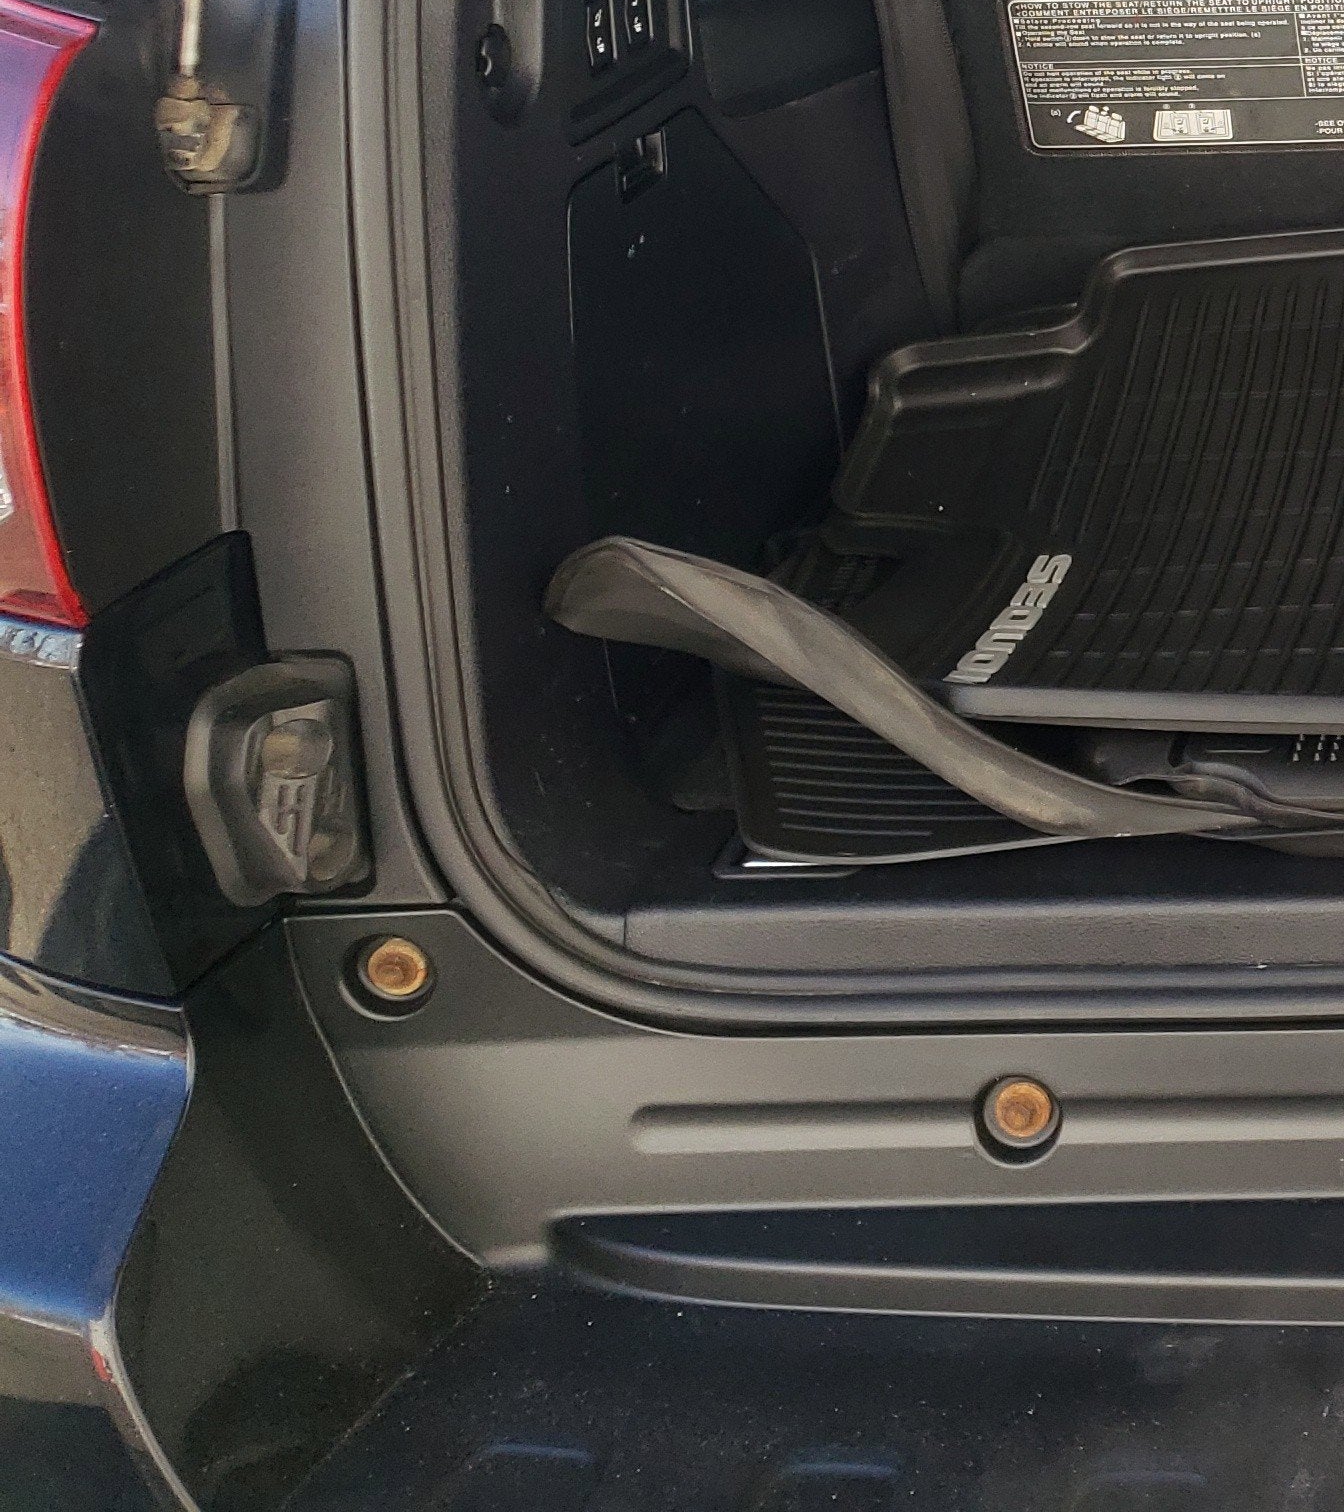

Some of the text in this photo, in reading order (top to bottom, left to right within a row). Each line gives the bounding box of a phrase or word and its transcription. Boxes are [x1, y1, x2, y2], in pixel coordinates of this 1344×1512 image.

[1062, 1, 1089, 9] STOW
[1115, 0, 1182, 8] SEAT/RETURN
[1187, 0, 1205, 7] THE
[1073, 8, 1138, 16] ENTREPOSER
[1142, 7, 1153, 15] LE
[1247, 5, 1258, 13] LE
[943, 554, 1072, 684] SEQUOI
